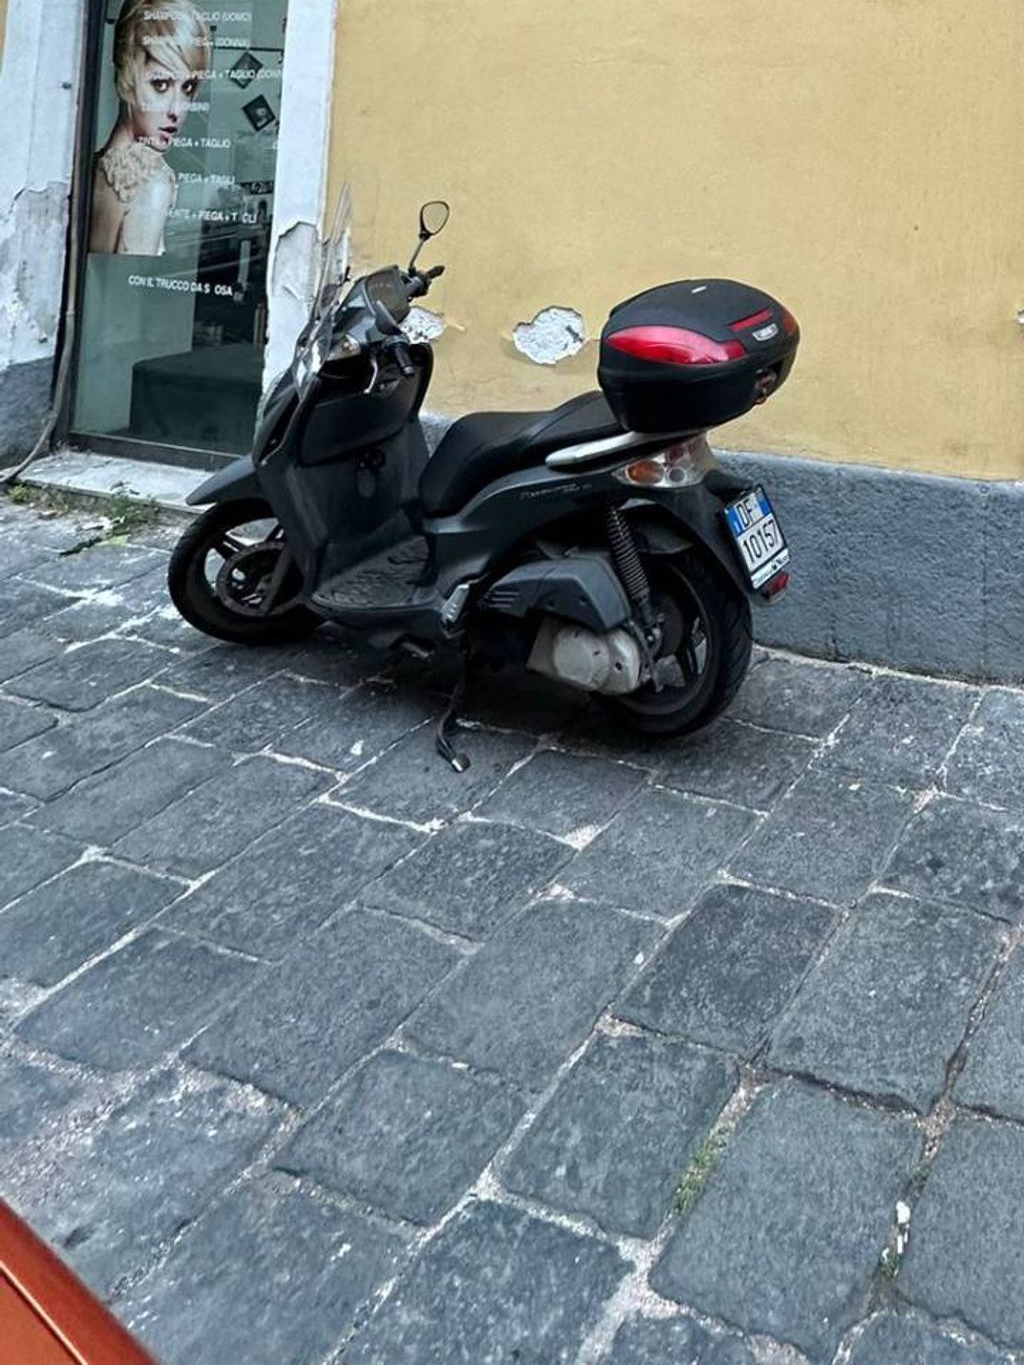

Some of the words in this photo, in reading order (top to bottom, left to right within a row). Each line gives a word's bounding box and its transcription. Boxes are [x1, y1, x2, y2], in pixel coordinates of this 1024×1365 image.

[200, 137, 231, 149] TAGLIO
[128, 274, 146, 286] CON
[155, 277, 189, 292] TRUCCO
[744, 519, 779, 564] 10157
